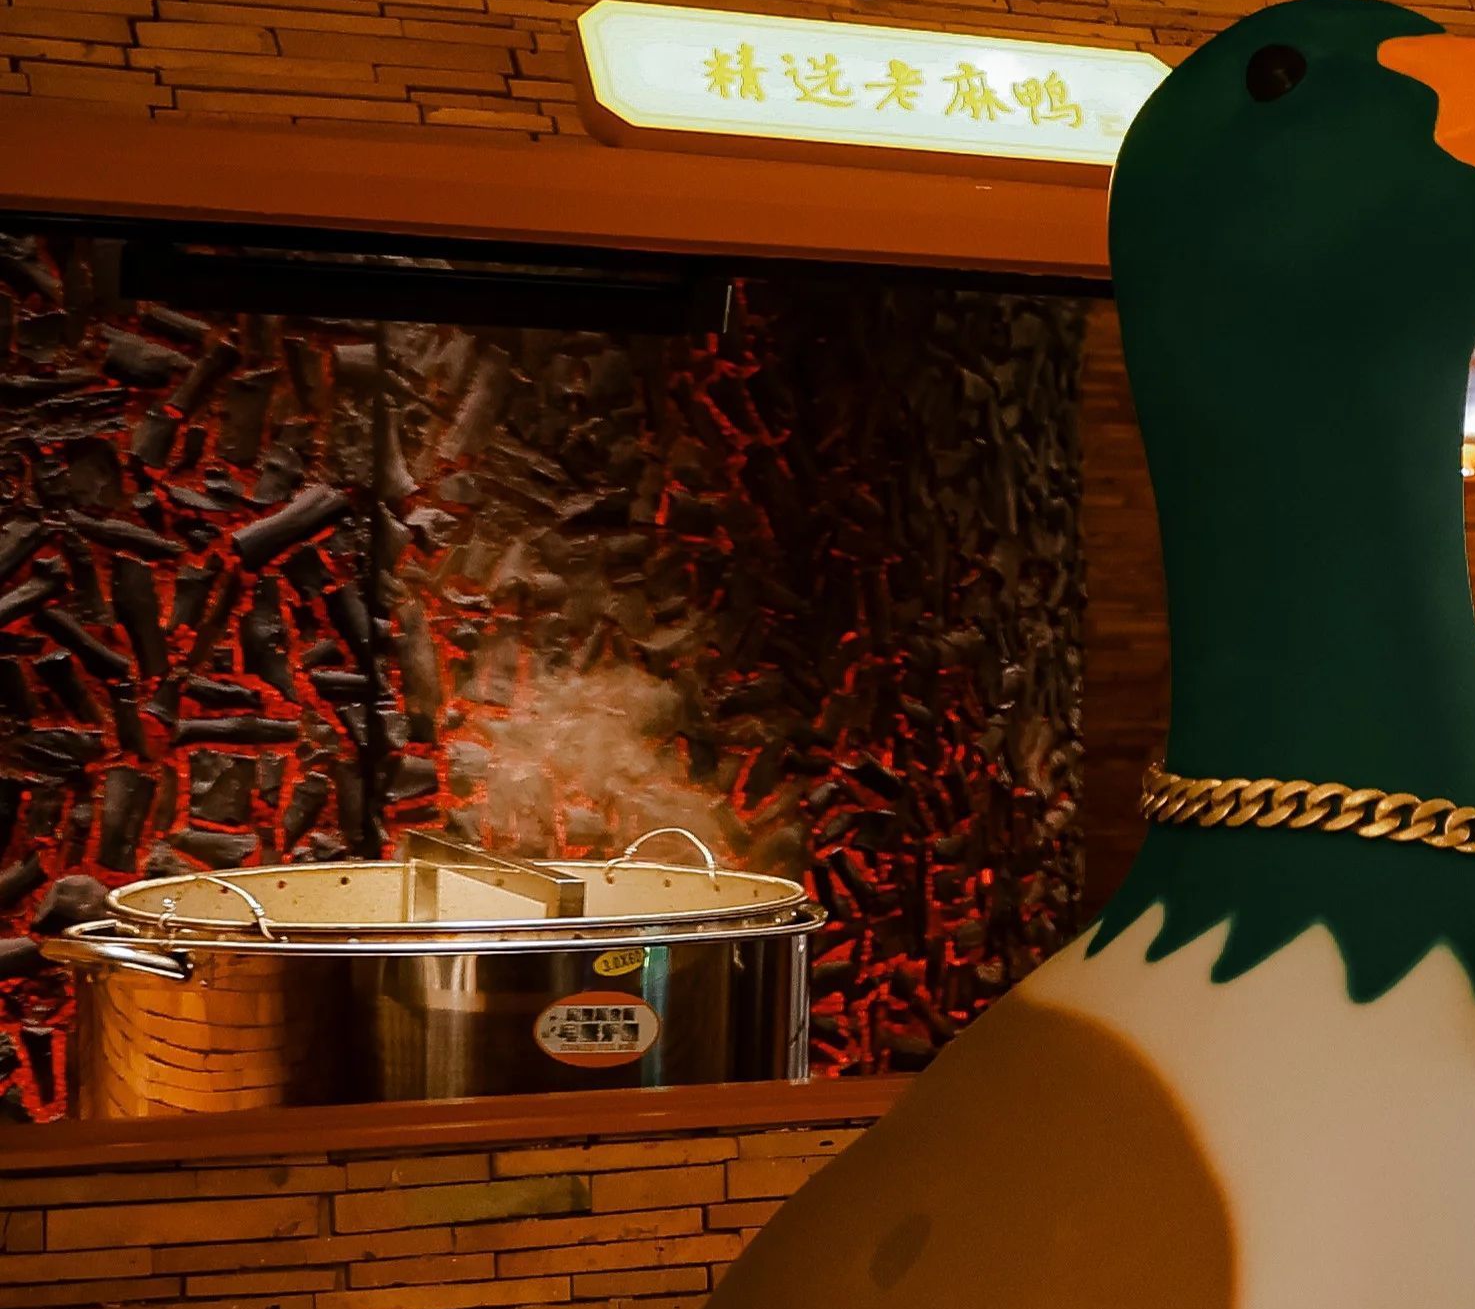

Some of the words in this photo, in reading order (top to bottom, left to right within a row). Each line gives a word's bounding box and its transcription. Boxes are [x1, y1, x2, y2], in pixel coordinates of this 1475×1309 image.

[702, 41, 1086, 130] 精选老麻鸭
